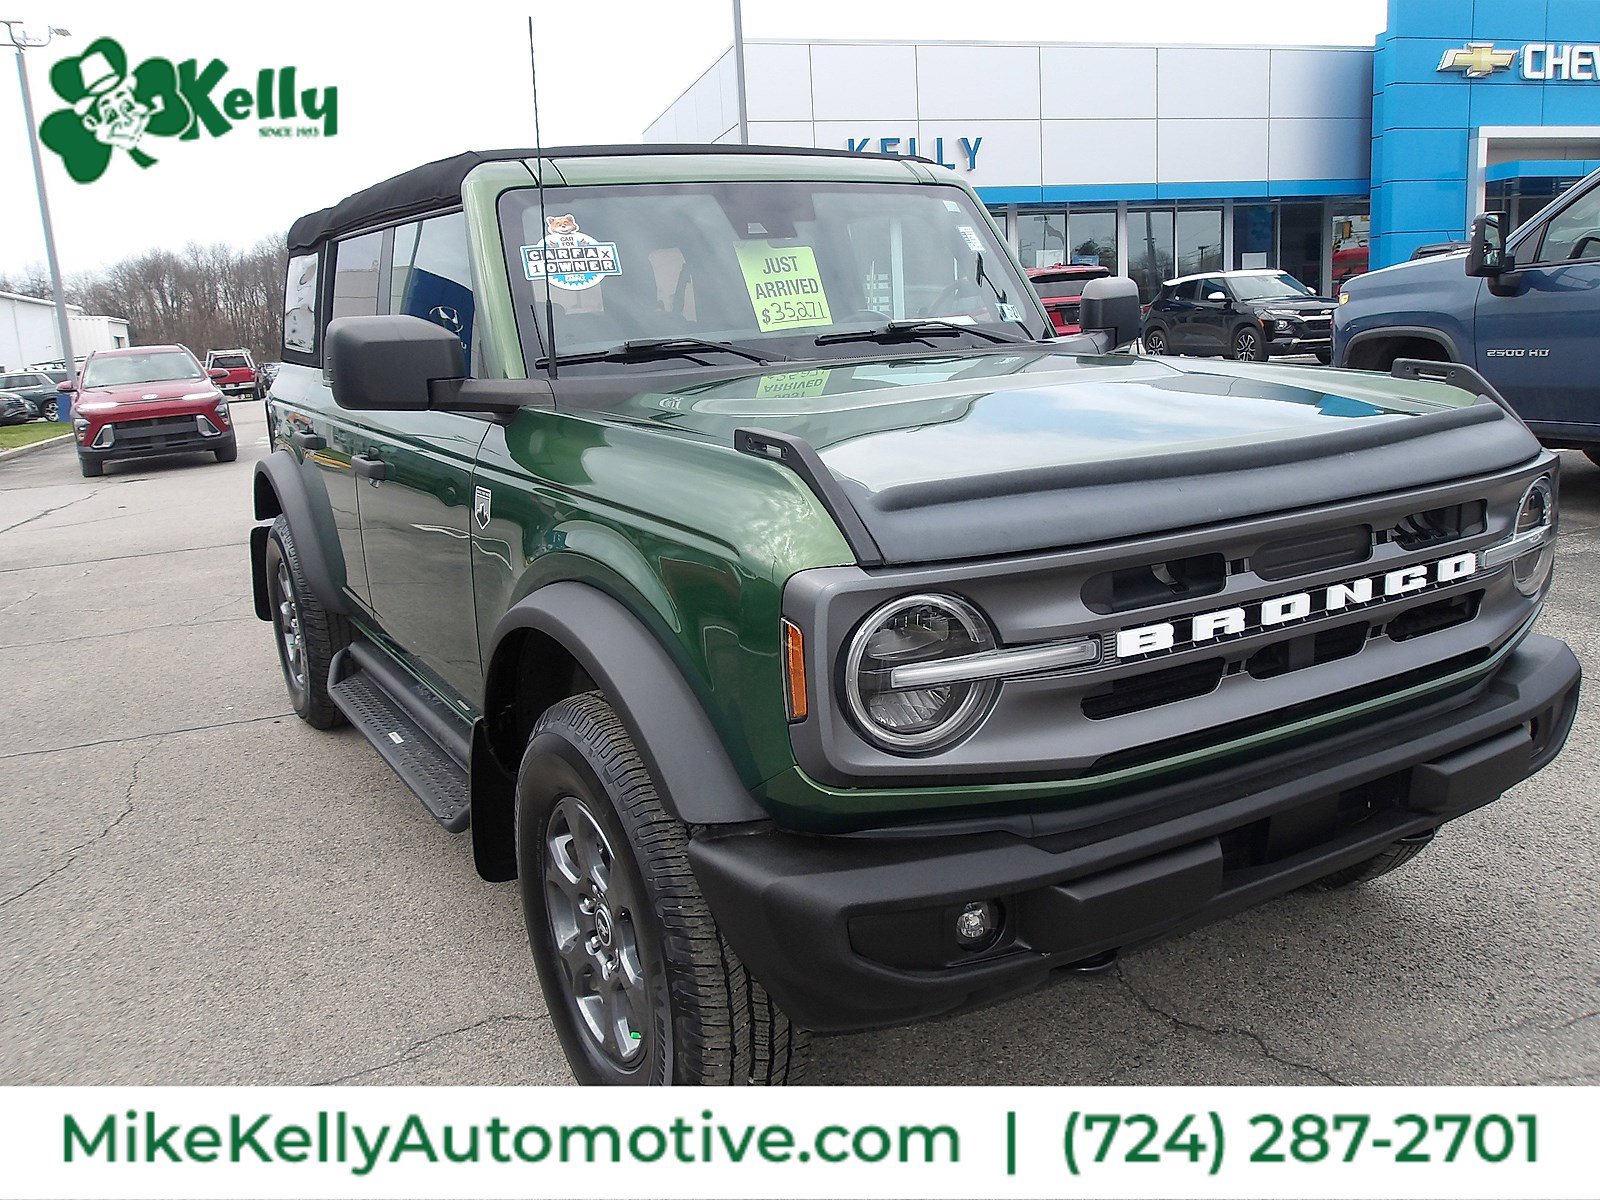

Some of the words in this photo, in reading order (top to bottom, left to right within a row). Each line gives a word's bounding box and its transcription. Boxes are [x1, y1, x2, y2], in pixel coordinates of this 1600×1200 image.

[527, 247, 612, 262] CARFAX
[546, 260, 616, 273] OWNER
[762, 255, 799, 275] JUST
[755, 277, 819, 300] ARRIVED
[761, 301, 826, 325] $35,271
[1486, 349, 1525, 357] 2500
[1528, 349, 1550, 357] HD
[1116, 552, 1477, 658] BRONCO
